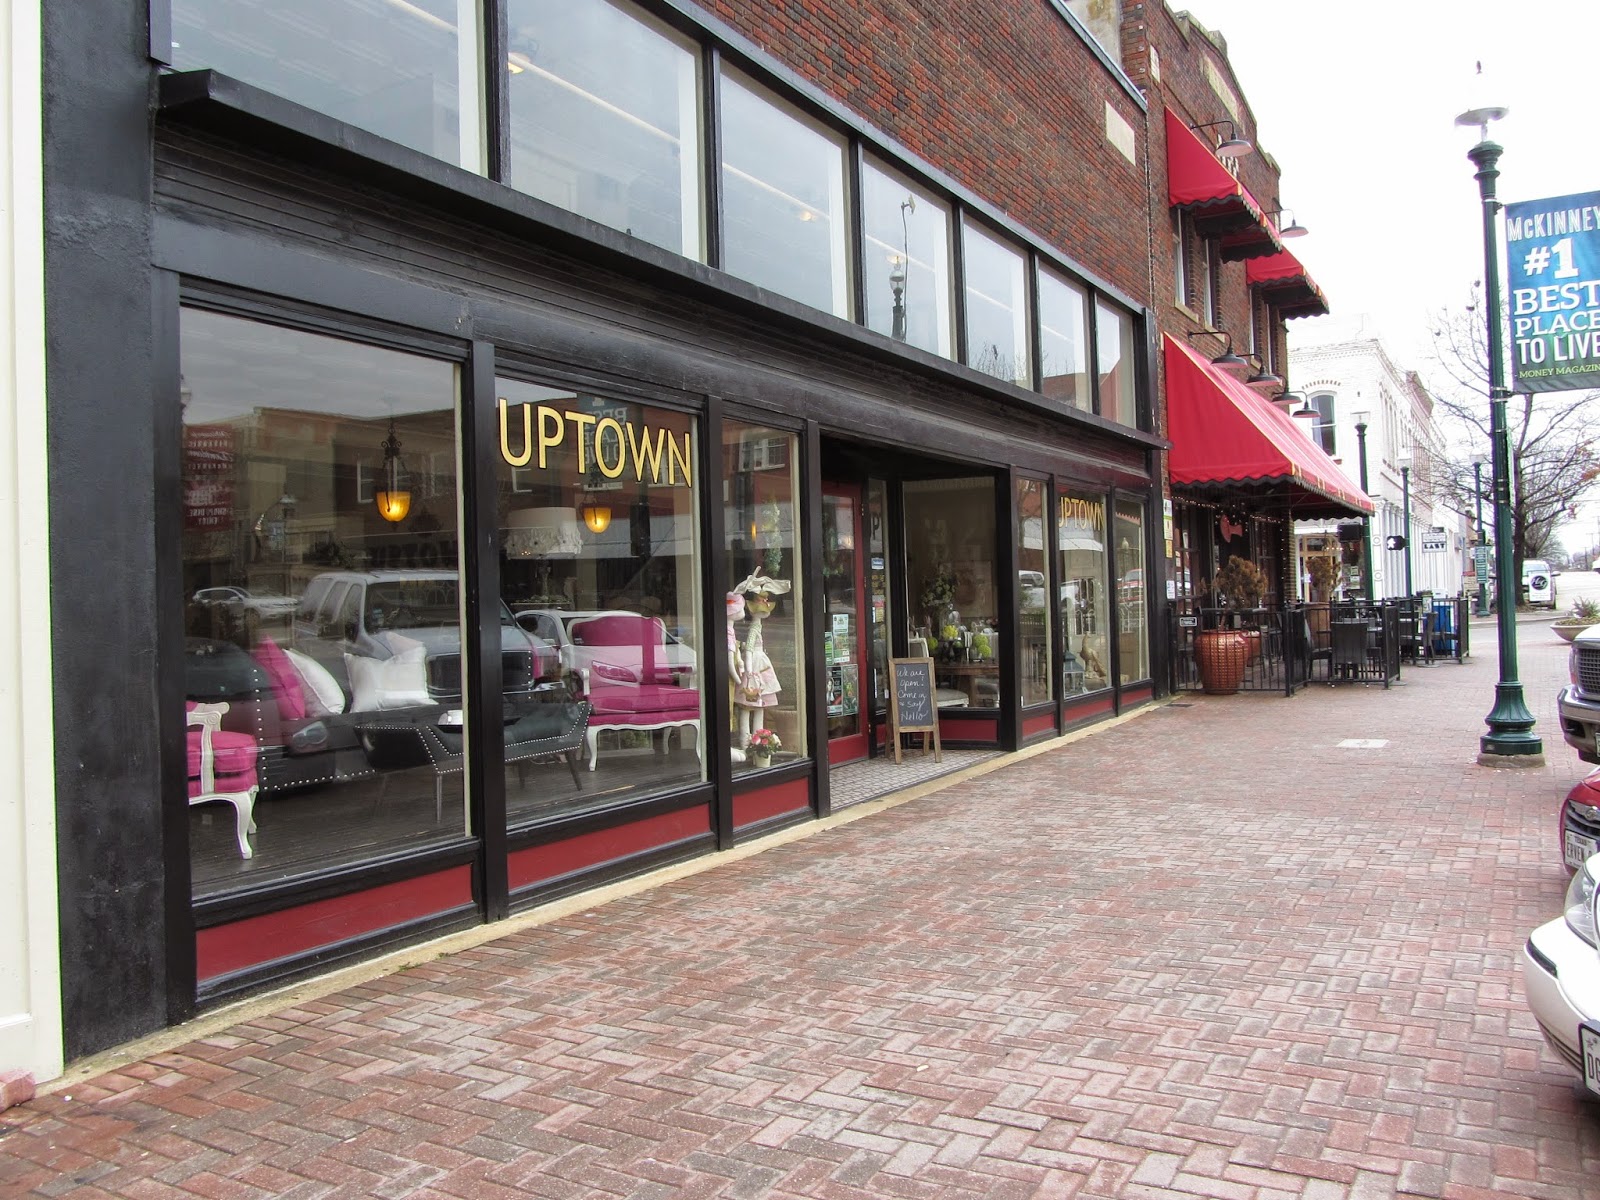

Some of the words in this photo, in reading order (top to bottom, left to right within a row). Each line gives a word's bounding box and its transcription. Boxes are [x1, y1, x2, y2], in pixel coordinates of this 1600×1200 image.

[1523, 238, 1579, 279] #1
[1513, 281, 1600, 315] BEST
[1515, 309, 1600, 338] PLACE
[1516, 337, 1545, 365] TO
[1553, 332, 1600, 362] LIVE
[1519, 368, 1554, 378] MONEY
[499, 397, 692, 488] UPTOWN
[897, 667, 909, 677] We
[898, 690, 917, 698] Come
[901, 710, 928, 721] Hello
